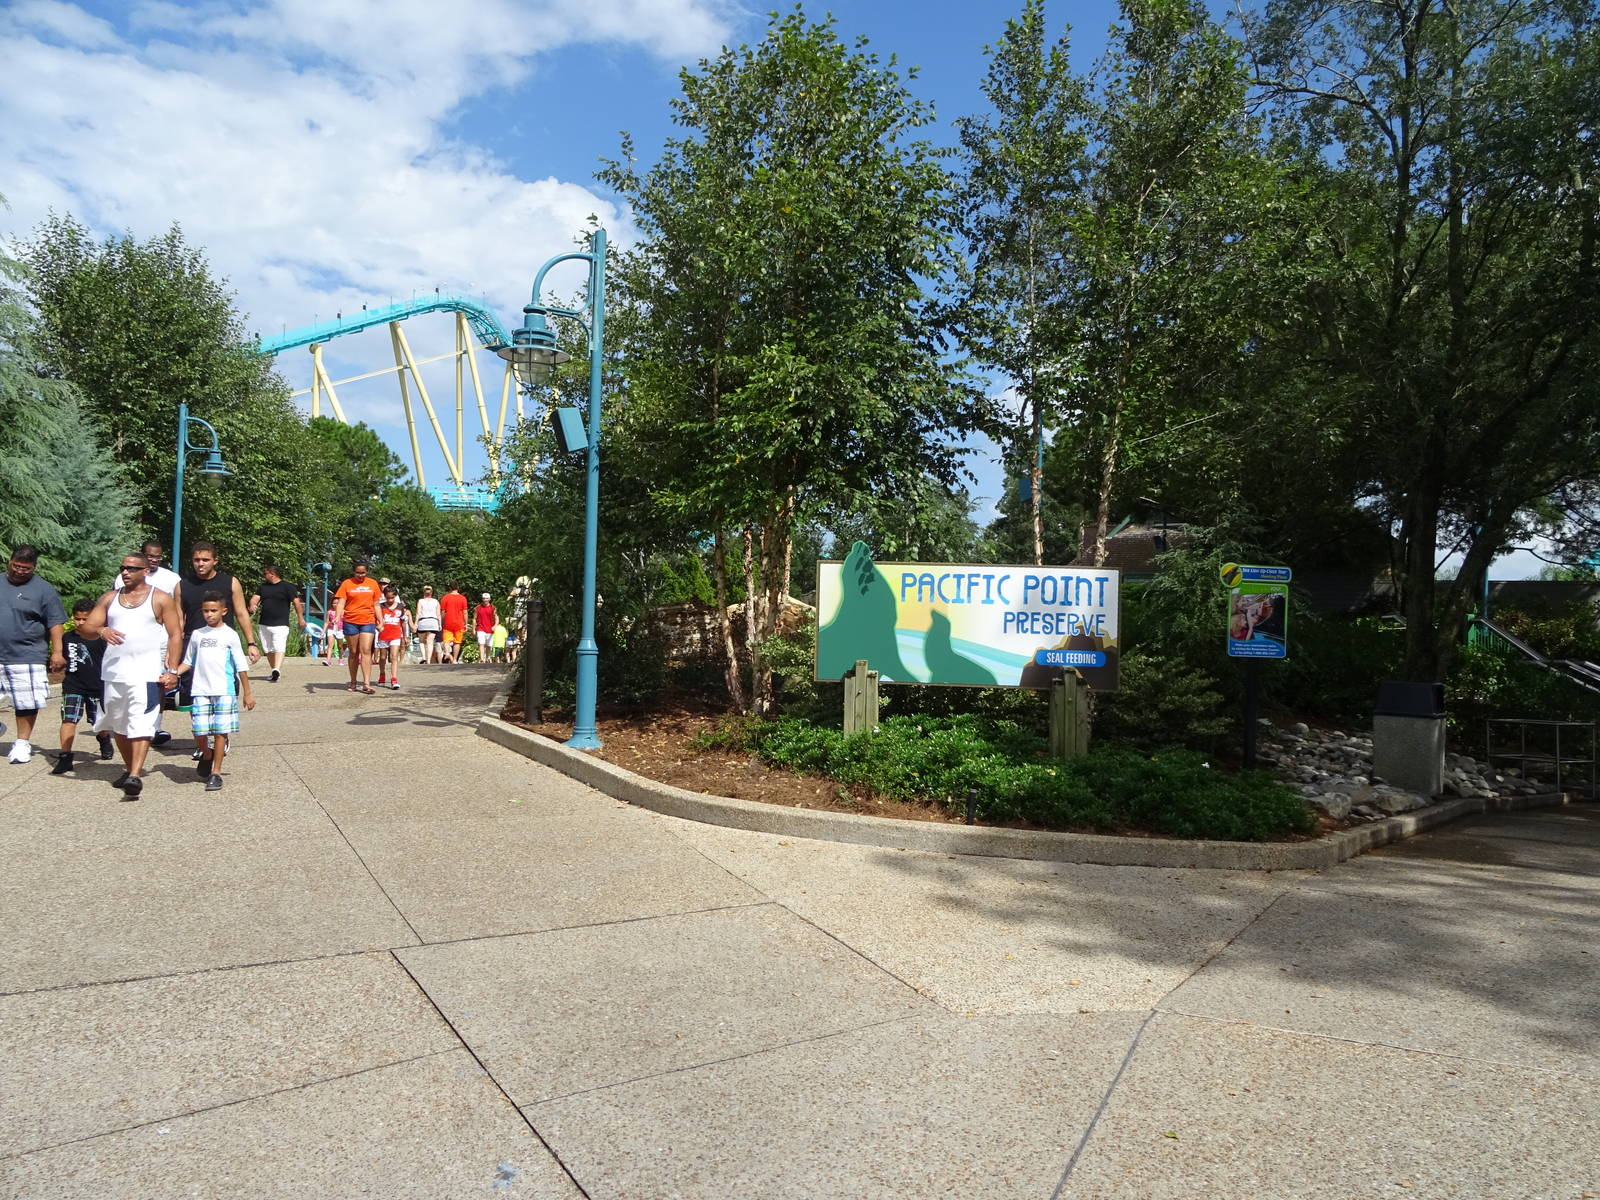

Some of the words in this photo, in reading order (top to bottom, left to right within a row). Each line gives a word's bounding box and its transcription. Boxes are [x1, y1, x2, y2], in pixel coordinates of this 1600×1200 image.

[901, 573, 1010, 605] PACIFIC
[1023, 575, 1109, 607] POINT
[1003, 611, 1106, 636] PRESERVE
[1046, 652, 1064, 664] SEAL
[1065, 652, 1097, 665] FEEDING
